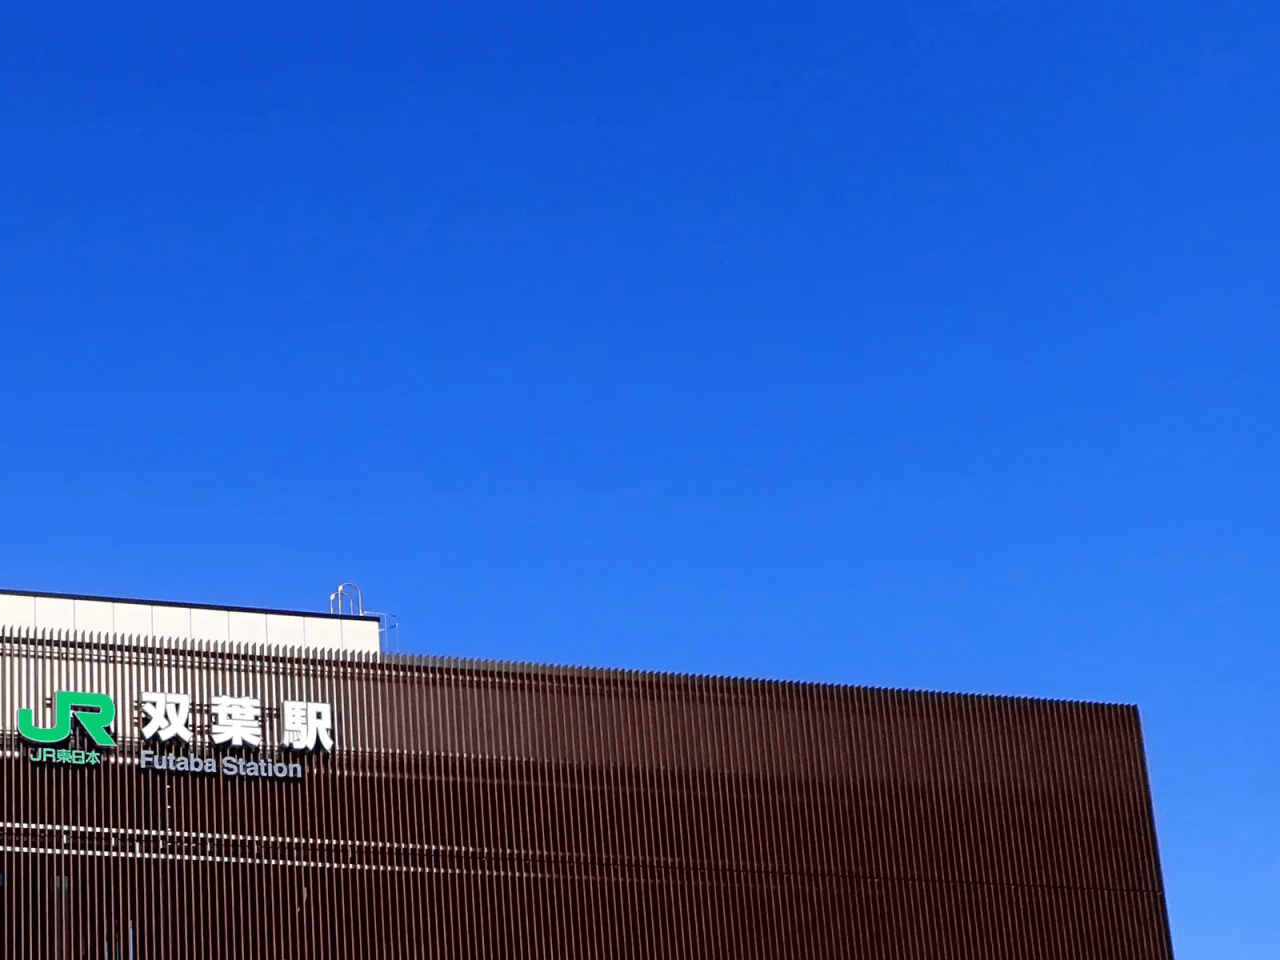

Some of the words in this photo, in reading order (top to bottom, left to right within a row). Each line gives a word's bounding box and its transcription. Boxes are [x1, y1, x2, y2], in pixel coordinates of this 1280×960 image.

[18, 690, 117, 747] JR
[140, 691, 334, 752] 双葉駅
[30, 747, 100, 765] JR東日本
[140, 750, 217, 774] Futaba
[222, 756, 303, 778] Station
